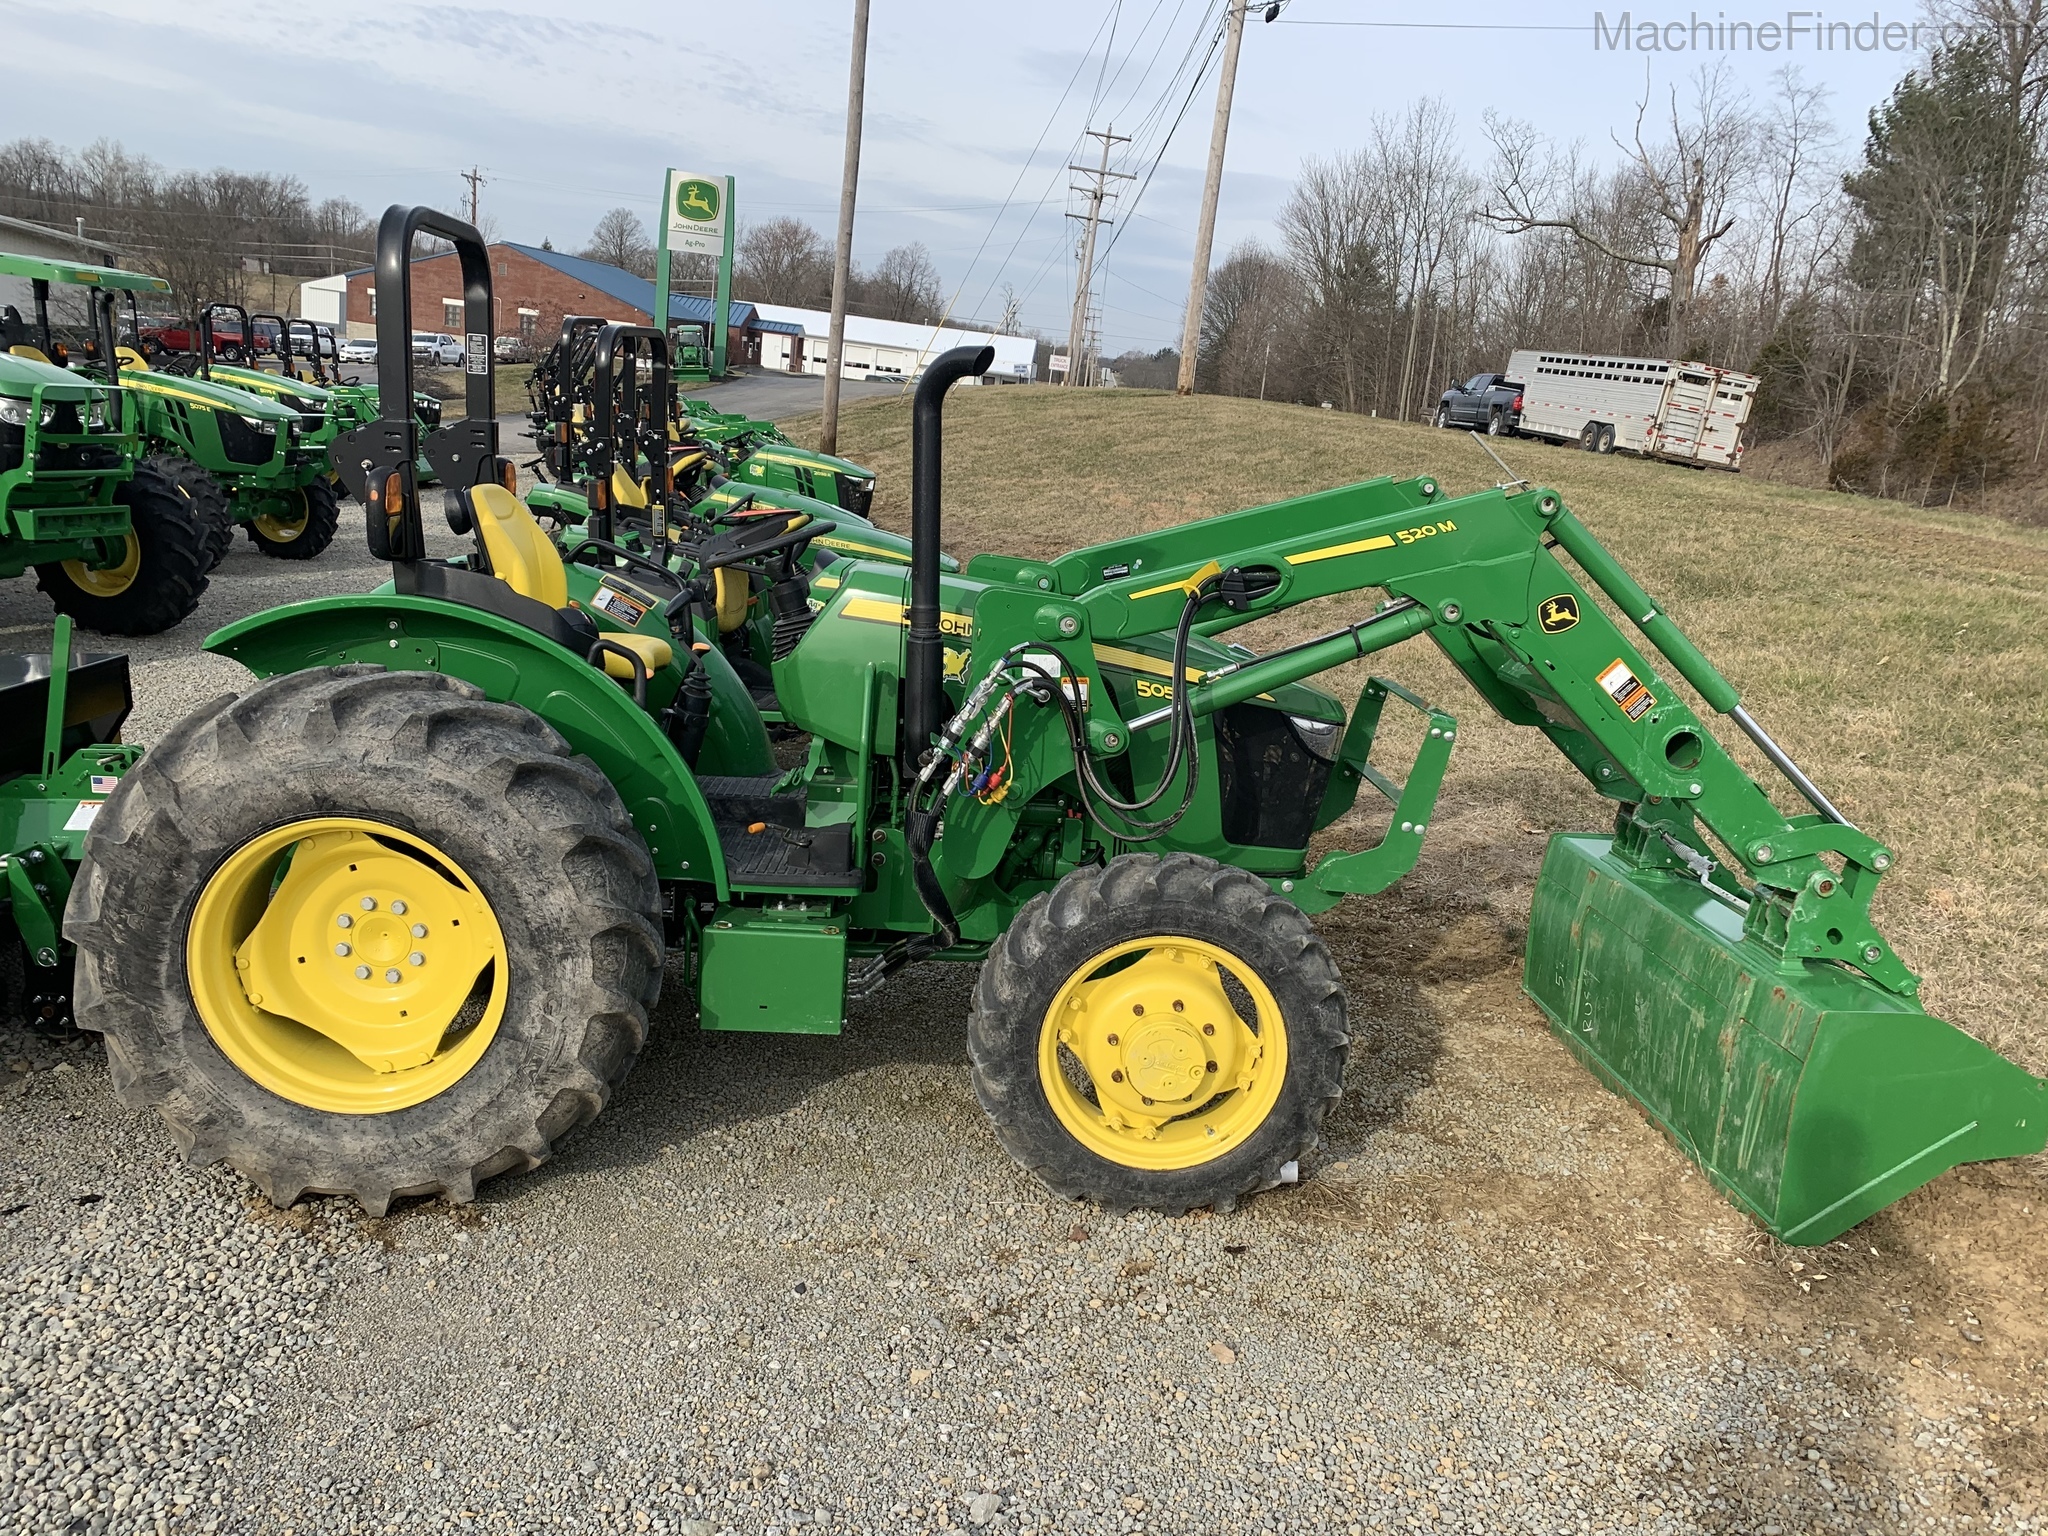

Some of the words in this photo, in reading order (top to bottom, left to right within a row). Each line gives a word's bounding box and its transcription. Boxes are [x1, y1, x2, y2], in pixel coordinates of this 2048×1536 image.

[674, 222, 693, 230] JOHN
[694, 224, 718, 233] DEERE
[685, 239, 705, 247] Ag-Pro
[1395, 525, 1437, 544] 520
[1436, 519, 1459, 533] M
[824, 539, 851, 549] DEERE
[1136, 679, 1173, 701] 505
